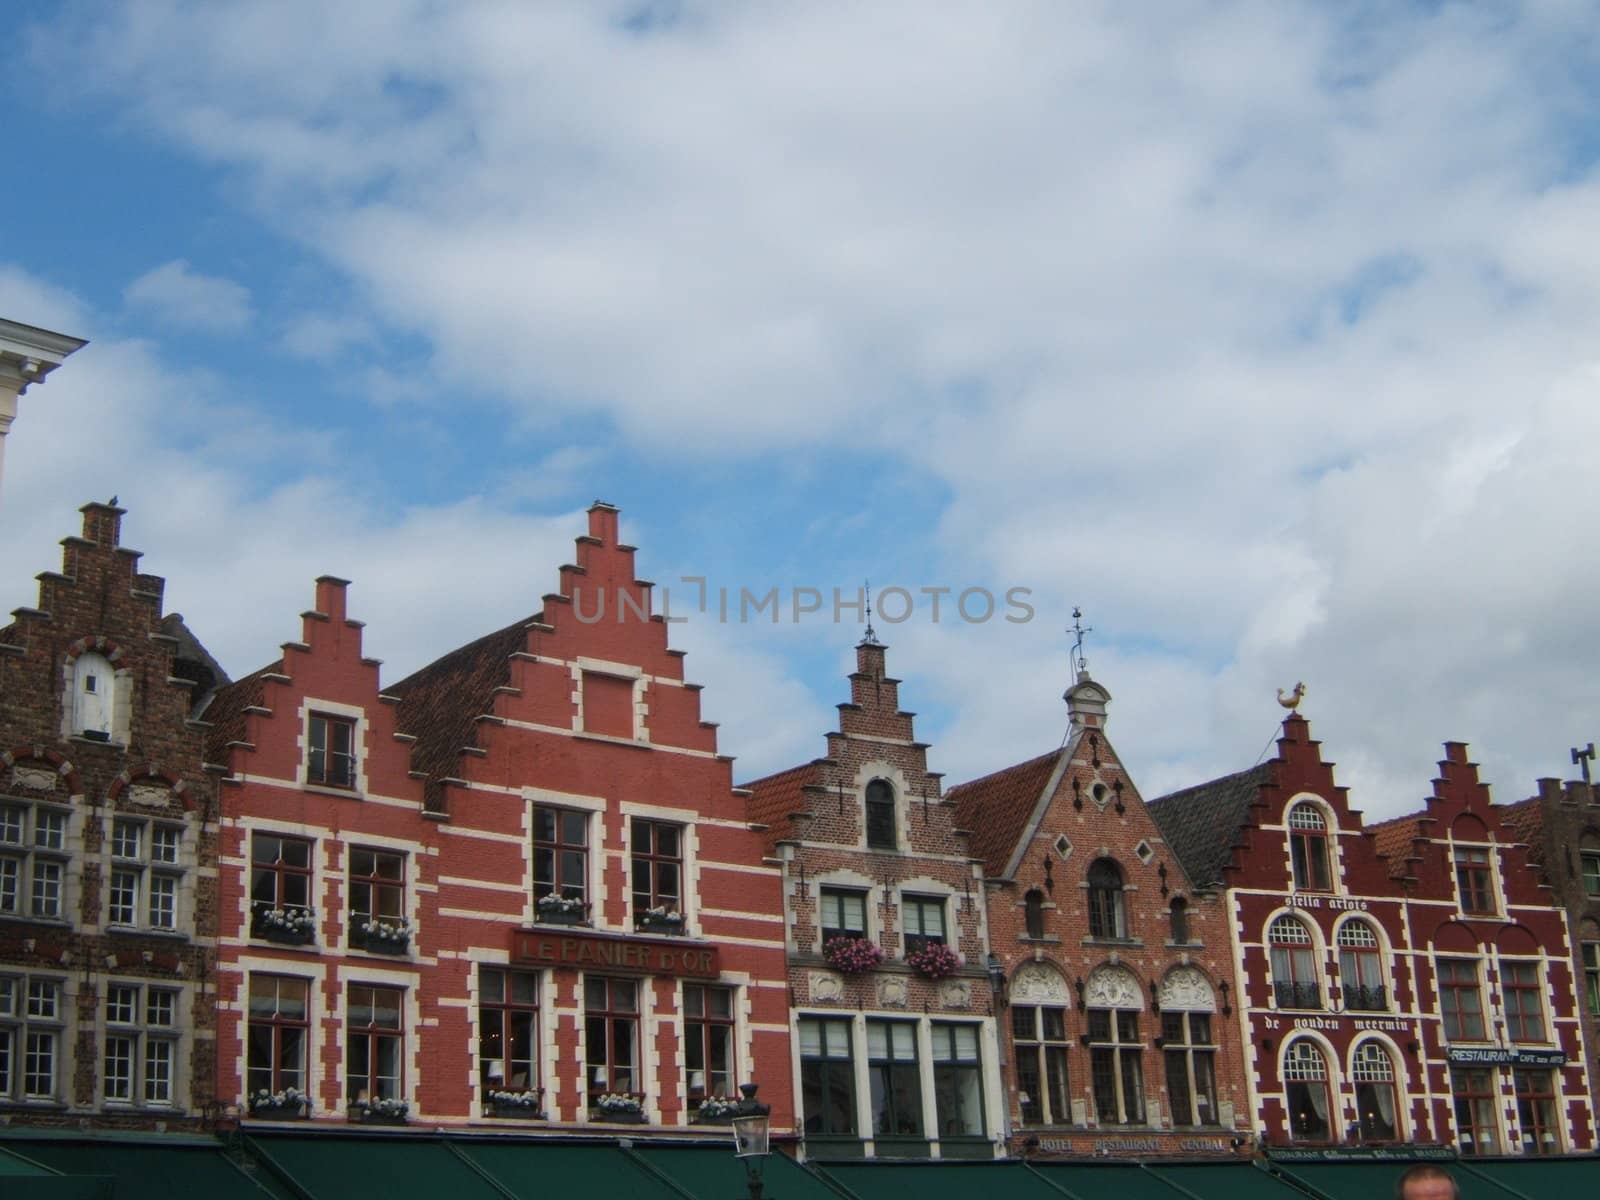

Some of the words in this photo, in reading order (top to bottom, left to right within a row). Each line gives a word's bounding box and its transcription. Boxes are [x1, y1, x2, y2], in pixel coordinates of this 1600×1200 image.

[1285, 895, 1320, 908] stella
[1329, 898, 1367, 910] artois
[521, 938, 555, 961] LE
[560, 937, 650, 967] PANIER
[1264, 1016, 1280, 1030] de
[1294, 1016, 1339, 1030] gouden
[1039, 1138, 1072, 1151] HOTEL
[1095, 1138, 1162, 1151] RESTAURANT
[1179, 1138, 1225, 1151] CENTRAL
